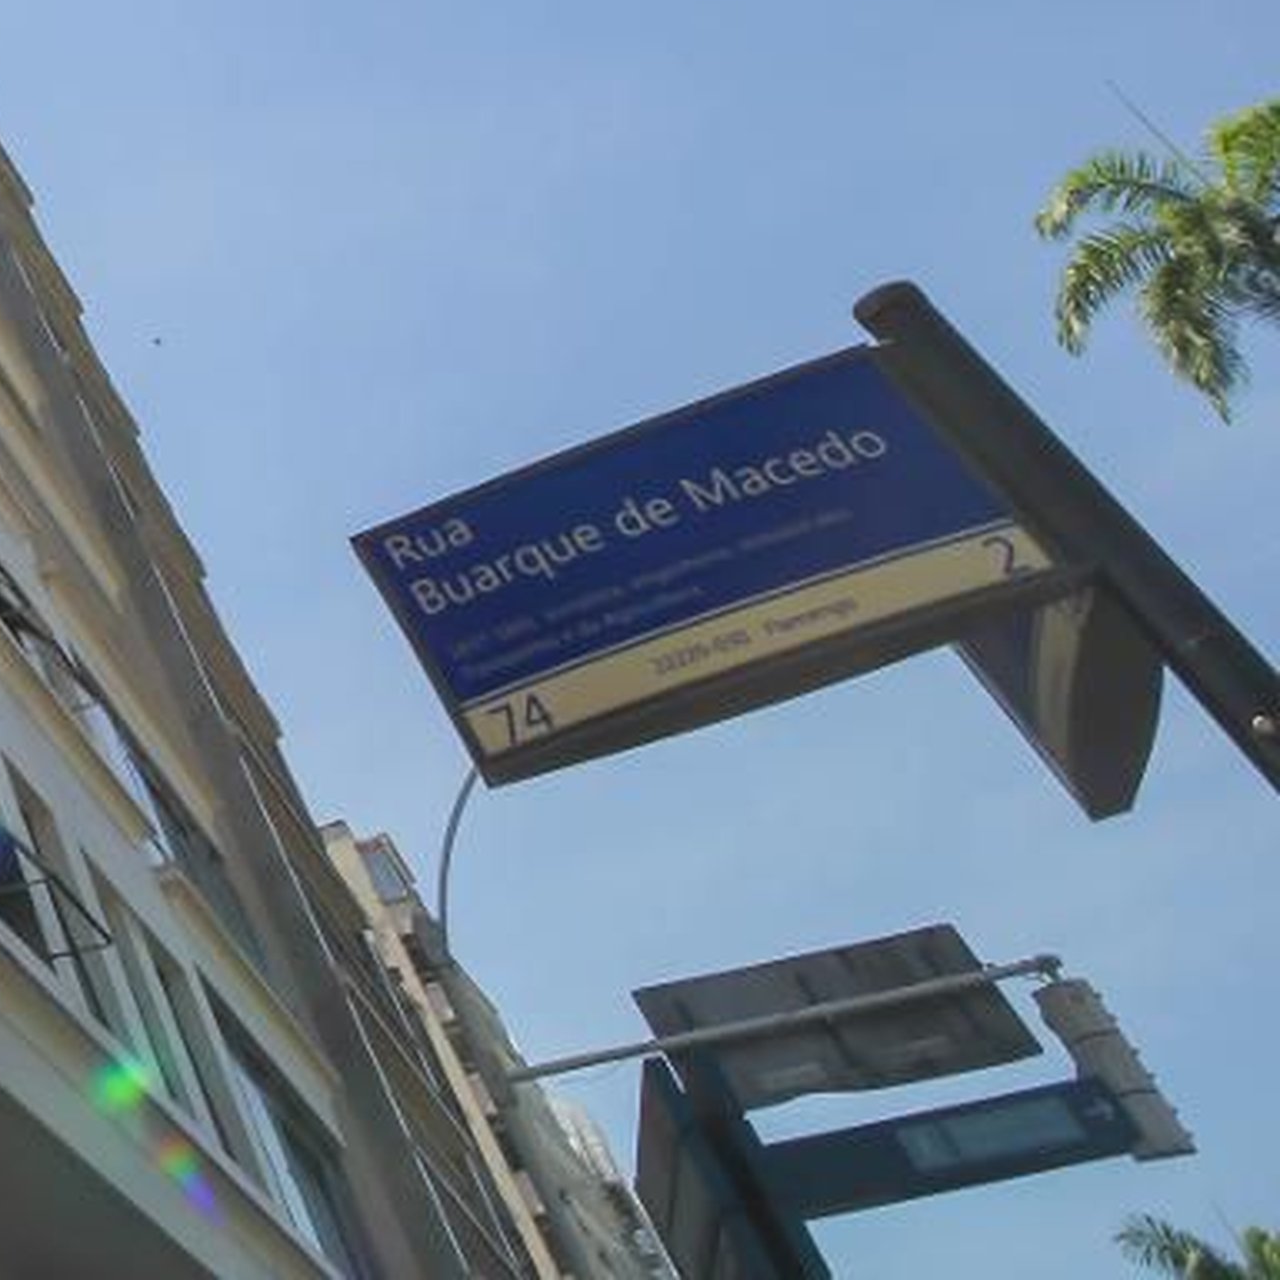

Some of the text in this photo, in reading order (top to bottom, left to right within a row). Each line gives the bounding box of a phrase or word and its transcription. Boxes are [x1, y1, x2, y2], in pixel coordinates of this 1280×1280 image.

[383, 518, 474, 568] Rua
[410, 523, 606, 614] Buarque
[615, 496, 680, 538] de
[680, 427, 887, 510] Macedo
[982, 536, 1028, 583] 2
[486, 694, 554, 746] 74
